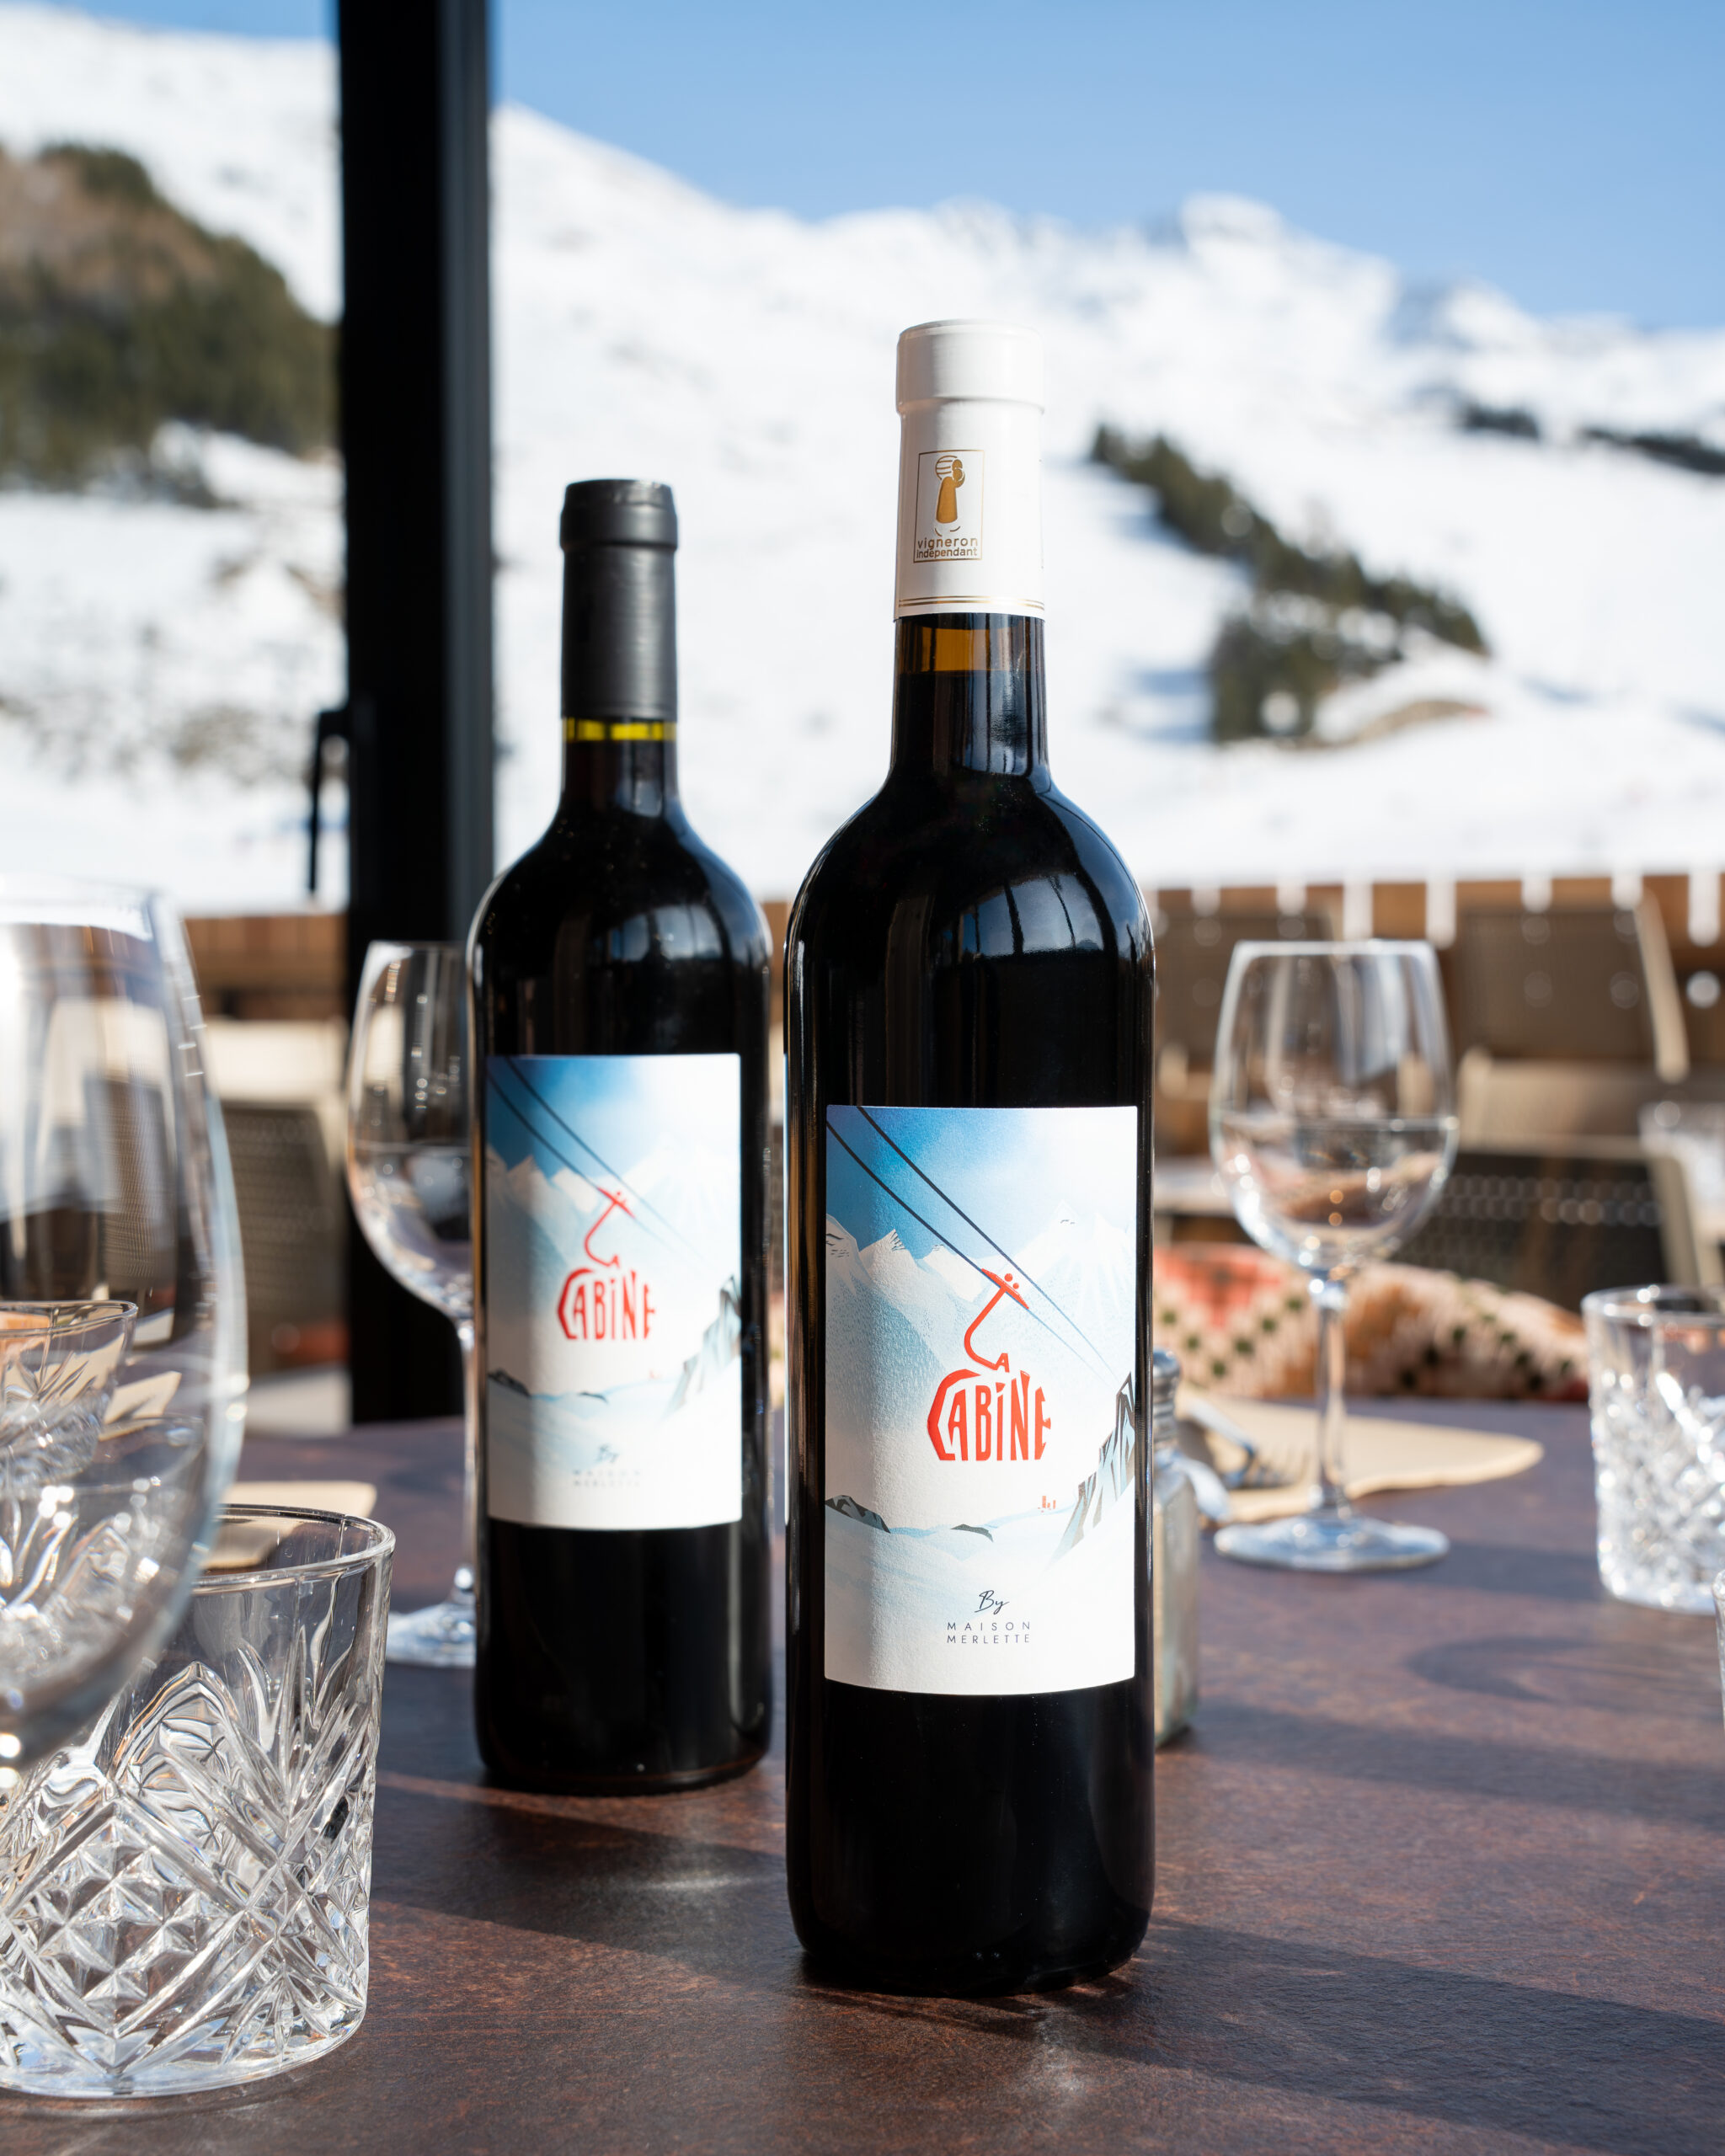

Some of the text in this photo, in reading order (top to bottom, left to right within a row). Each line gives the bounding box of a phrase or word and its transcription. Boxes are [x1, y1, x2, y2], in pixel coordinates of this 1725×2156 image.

[917, 537, 978, 550] vigneron
[974, 1589, 1010, 1615] By
[947, 1621, 1030, 1631] MAISON
[947, 1634, 1030, 1644] MERLETTE
